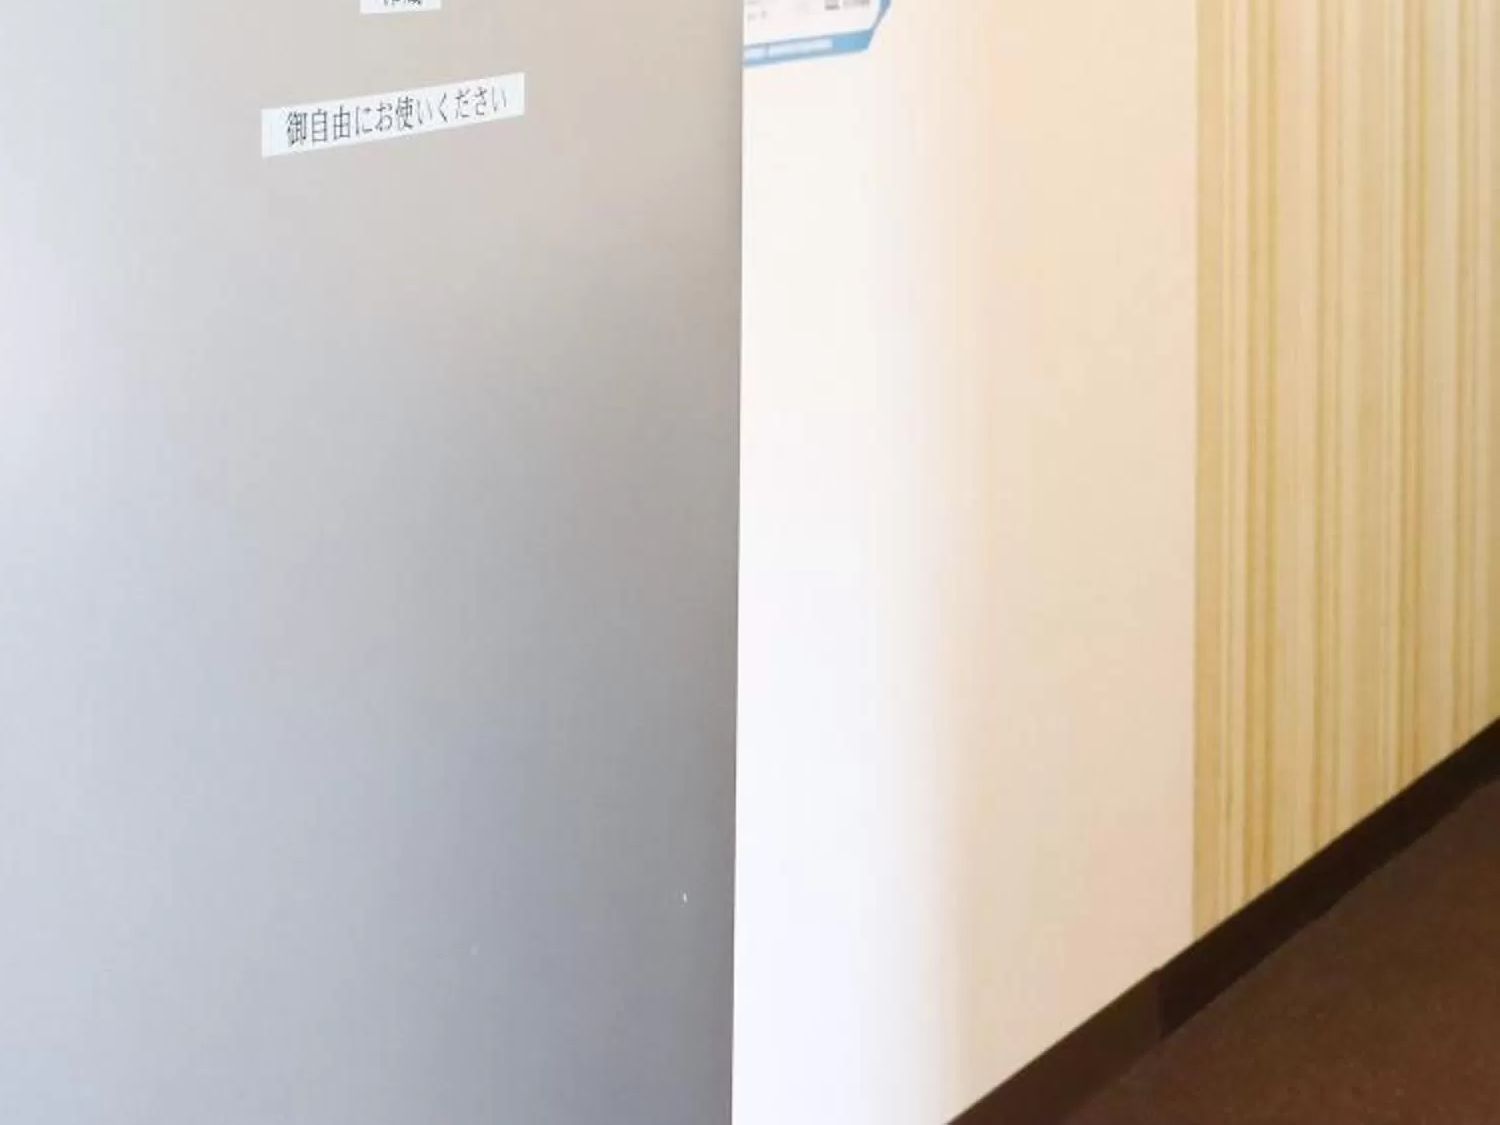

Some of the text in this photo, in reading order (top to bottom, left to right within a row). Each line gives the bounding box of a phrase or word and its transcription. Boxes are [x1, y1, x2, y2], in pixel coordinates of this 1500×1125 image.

[285, 85, 508, 148] 御自由にお使いください
